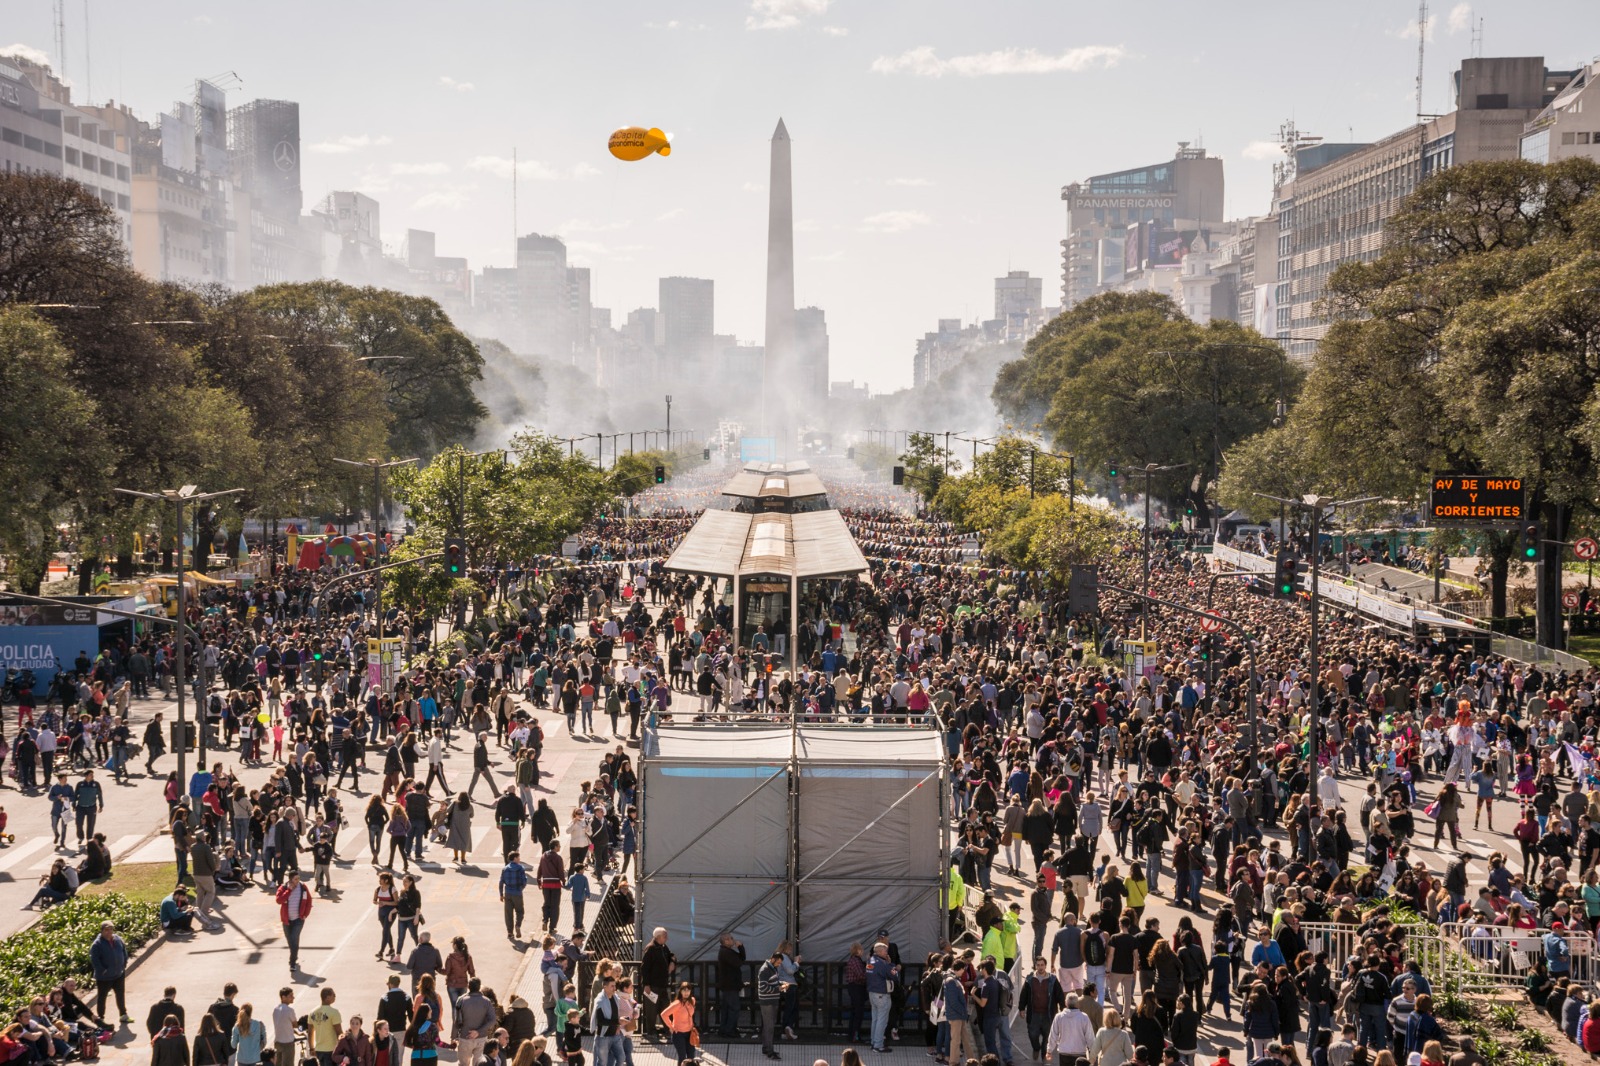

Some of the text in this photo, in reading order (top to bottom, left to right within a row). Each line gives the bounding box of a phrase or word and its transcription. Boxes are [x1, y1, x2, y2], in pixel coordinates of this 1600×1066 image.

[1076, 198, 1172, 208] PANAMERICANO
[1436, 480, 1521, 490] AV DE MAYO
[1469, 493, 1478, 503] Y
[1435, 506, 1520, 517] CORRIENTES
[0, 644, 54, 660] OLICIA
[20, 660, 54, 669] CIUDAD
